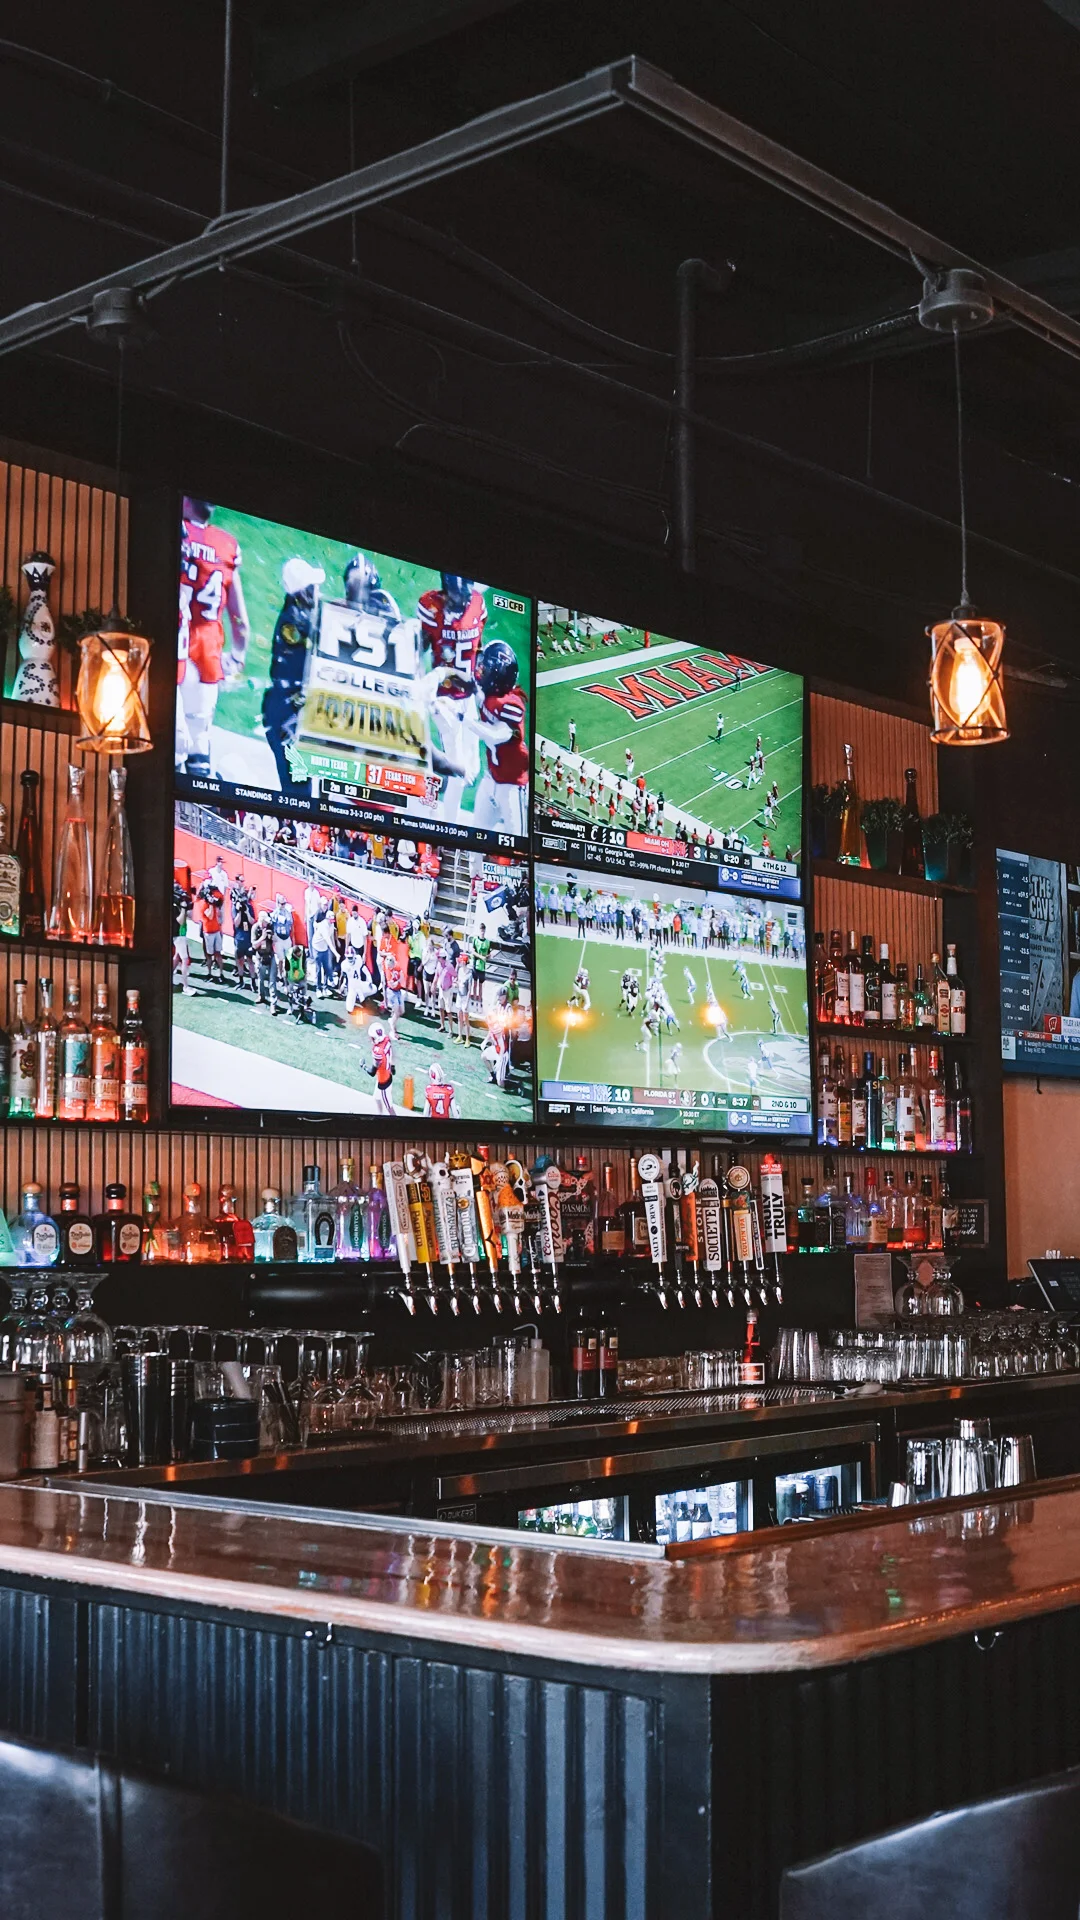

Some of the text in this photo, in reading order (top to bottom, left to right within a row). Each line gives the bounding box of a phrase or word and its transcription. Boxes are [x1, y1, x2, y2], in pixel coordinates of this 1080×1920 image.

[509, 599, 524, 613] CFB
[317, 601, 421, 676] FS1
[331, 758, 348, 771] TEXAS
[353, 761, 361, 780] 7
[368, 764, 383, 785] 37
[384, 770, 402, 782] TEXAS
[402, 774, 416, 785] TECH
[192, 780, 208, 790] LIGA
[209, 782, 220, 792] MX
[235, 787, 272, 801] STANDINGS
[298, 799, 311, 809] pts)
[319, 803, 328, 812] 10.
[328, 804, 349, 816] Necaxa
[373, 812, 384, 823] pts)
[401, 818, 419, 829] Pumas
[419, 821, 435, 832] UNAM
[551, 820, 585, 833] CINCINNATI
[609, 831, 625, 845] 10
[498, 834, 515, 848] FS1
[587, 844, 597, 852] VMI
[604, 847, 623, 858] Georgia
[623, 851, 634, 859] Tech
[483, 863, 496, 873] FOX
[693, 846, 701, 858] 3
[723, 853, 740, 865] 6:20
[762, 861, 775, 871] 4TH
[780, 864, 787, 873] 12
[1031, 875, 1052, 899] THE
[1030, 895, 1055, 922] CAVE
[563, 1084, 590, 1093] MEMPHIS
[614, 1088, 630, 1102] 10
[643, 1090, 667, 1098] FLORIDA
[548, 1103, 571, 1114] ESPN
[592, 1105, 602, 1113] San
[603, 1106, 617, 1114] Diego
[631, 1107, 654, 1115] California
[701, 1093, 709, 1106] 0
[731, 1097, 748, 1107] 8:37
[771, 1100, 784, 1108] 2ND
[790, 1101, 797, 1109] 10
[446, 1196, 459, 1251] BUENAVEZA
[539, 1197, 552, 1257] Coors LIGHT
[548, 1191, 562, 1250] Coors
[696, 1198, 704, 1243] STONE
[763, 1193, 773, 1240] TRULY
[772, 1192, 785, 1240] TRULY
[461, 1210, 477, 1257] Corona
[705, 1209, 720, 1261] SOCIETE
[740, 1230, 748, 1257] SCULPIN
